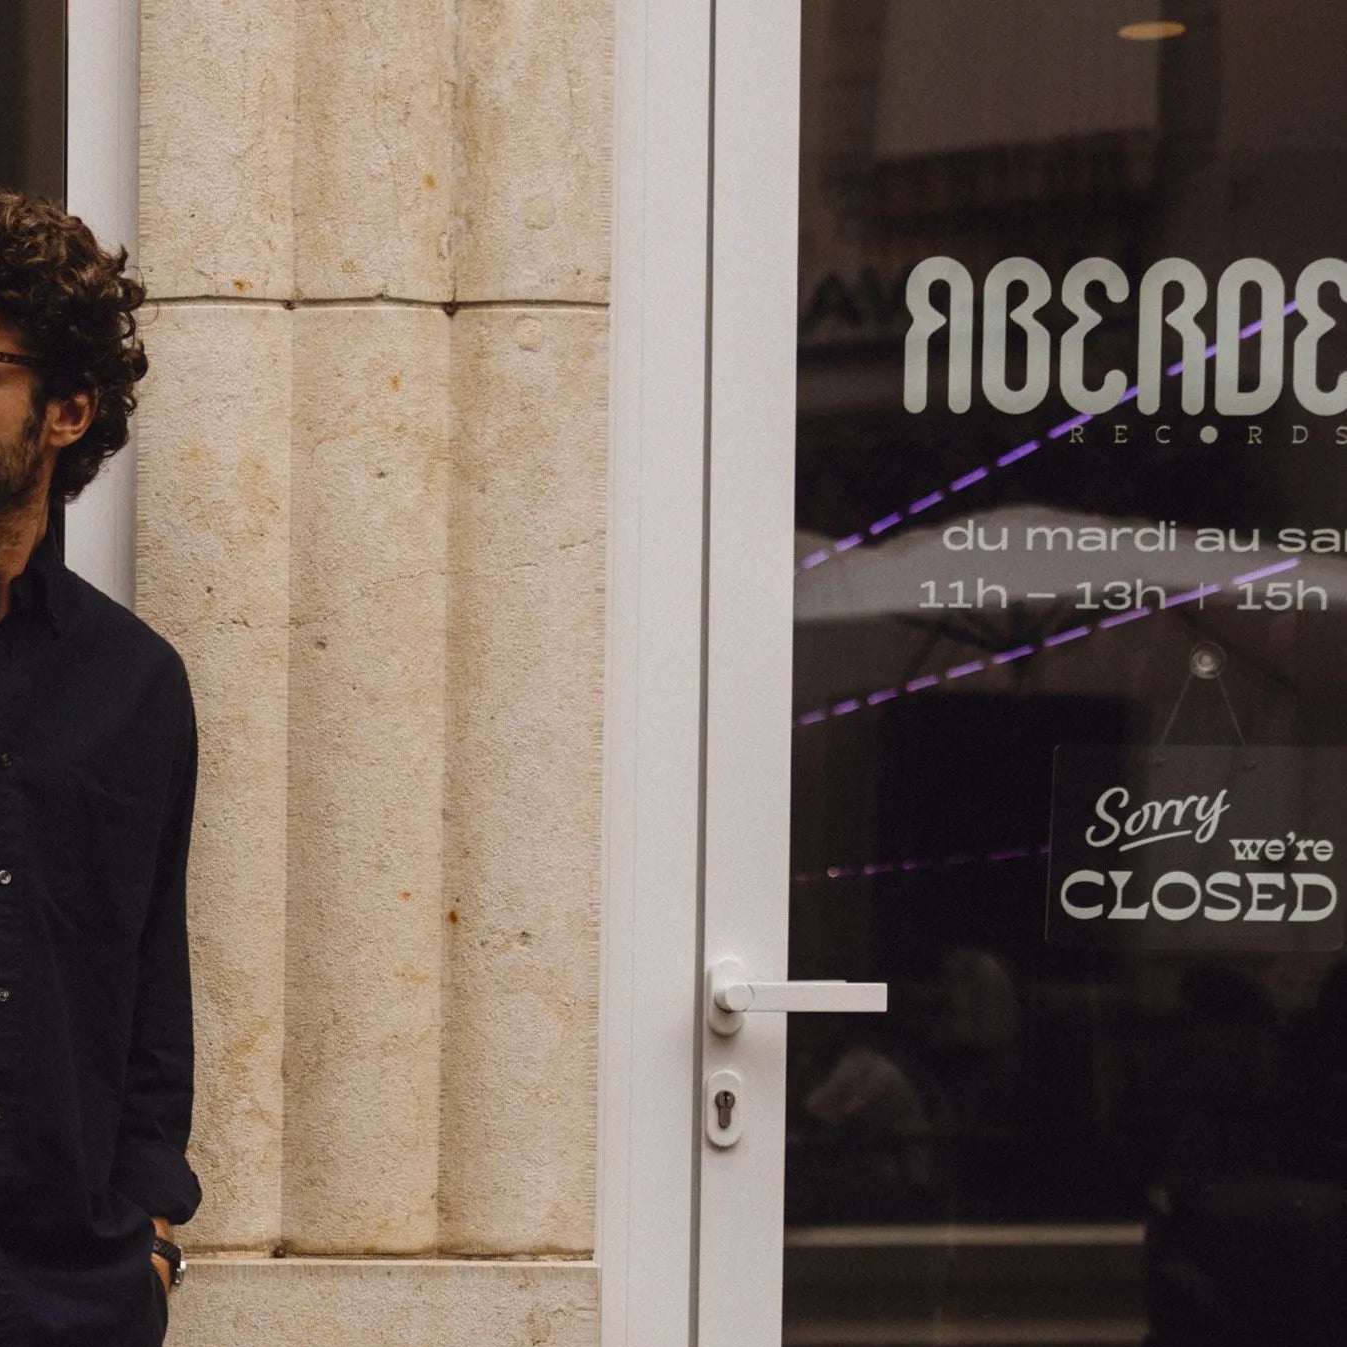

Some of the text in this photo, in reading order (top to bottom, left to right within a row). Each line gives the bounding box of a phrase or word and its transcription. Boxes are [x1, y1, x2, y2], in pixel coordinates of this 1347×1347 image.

[942, 520, 1347, 553] du mardi au sa
[918, 579, 1008, 609] 11h
[1075, 580, 1166, 610] 13h
[1236, 580, 1328, 611] 15h
[1085, 787, 1231, 852] Sorry
[1229, 831, 1334, 862] we're
[1060, 869, 1338, 922] CLOSED
